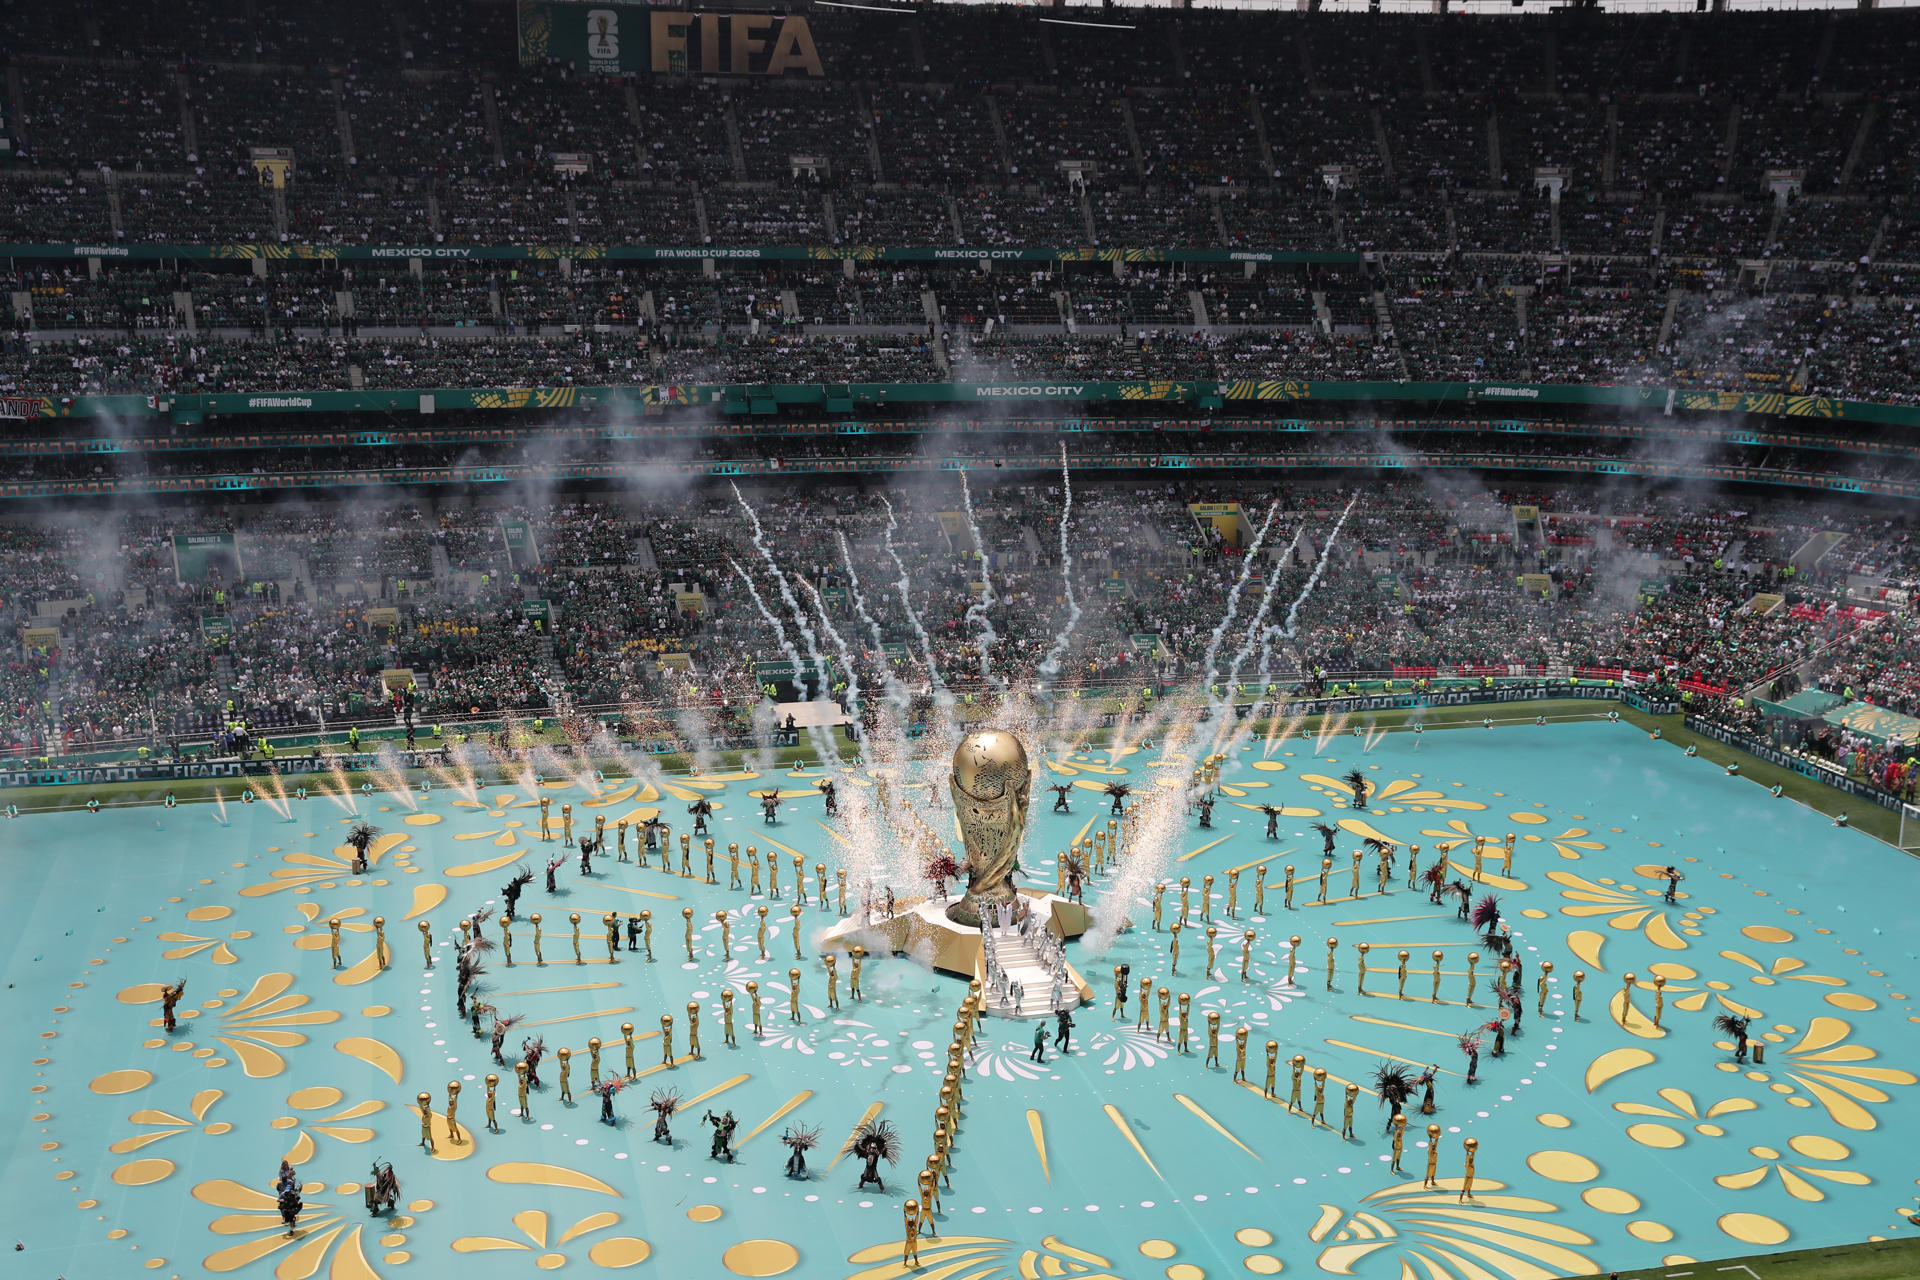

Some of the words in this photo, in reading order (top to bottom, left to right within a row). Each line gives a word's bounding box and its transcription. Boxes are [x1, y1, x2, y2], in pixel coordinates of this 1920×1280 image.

[650, 11, 825, 76] FIFA
[74, 246, 129, 257] #FIFAWorldCup
[371, 248, 432, 257] MEXICO
[435, 248, 471, 257] CITY
[655, 249, 675, 257] FIFA
[676, 249, 709, 257] WORLD
[710, 249, 728, 257] CUP
[729, 249, 760, 257] 2026
[935, 250, 989, 258] MEXICO
[991, 250, 1023, 258] CITY
[976, 386, 1042, 396] MEXICO
[1044, 386, 1084, 395] CITY
[1484, 387, 1539, 398] #FIFAWorldCup
[248, 397, 312, 408] #FIFAWorldCup
[1421, 693, 1448, 706] FIFA
[1497, 688, 1523, 701] FIFA
[1574, 686, 1602, 699] FIFA
[1694, 720, 1714, 737] FIFA
[1750, 741, 1771, 760] FIFA
[1877, 791, 1903, 810] FIFA
[67, 770, 105, 784] FIFA
[174, 764, 212, 778] FIFA
[278, 759, 315, 773] FIFA
